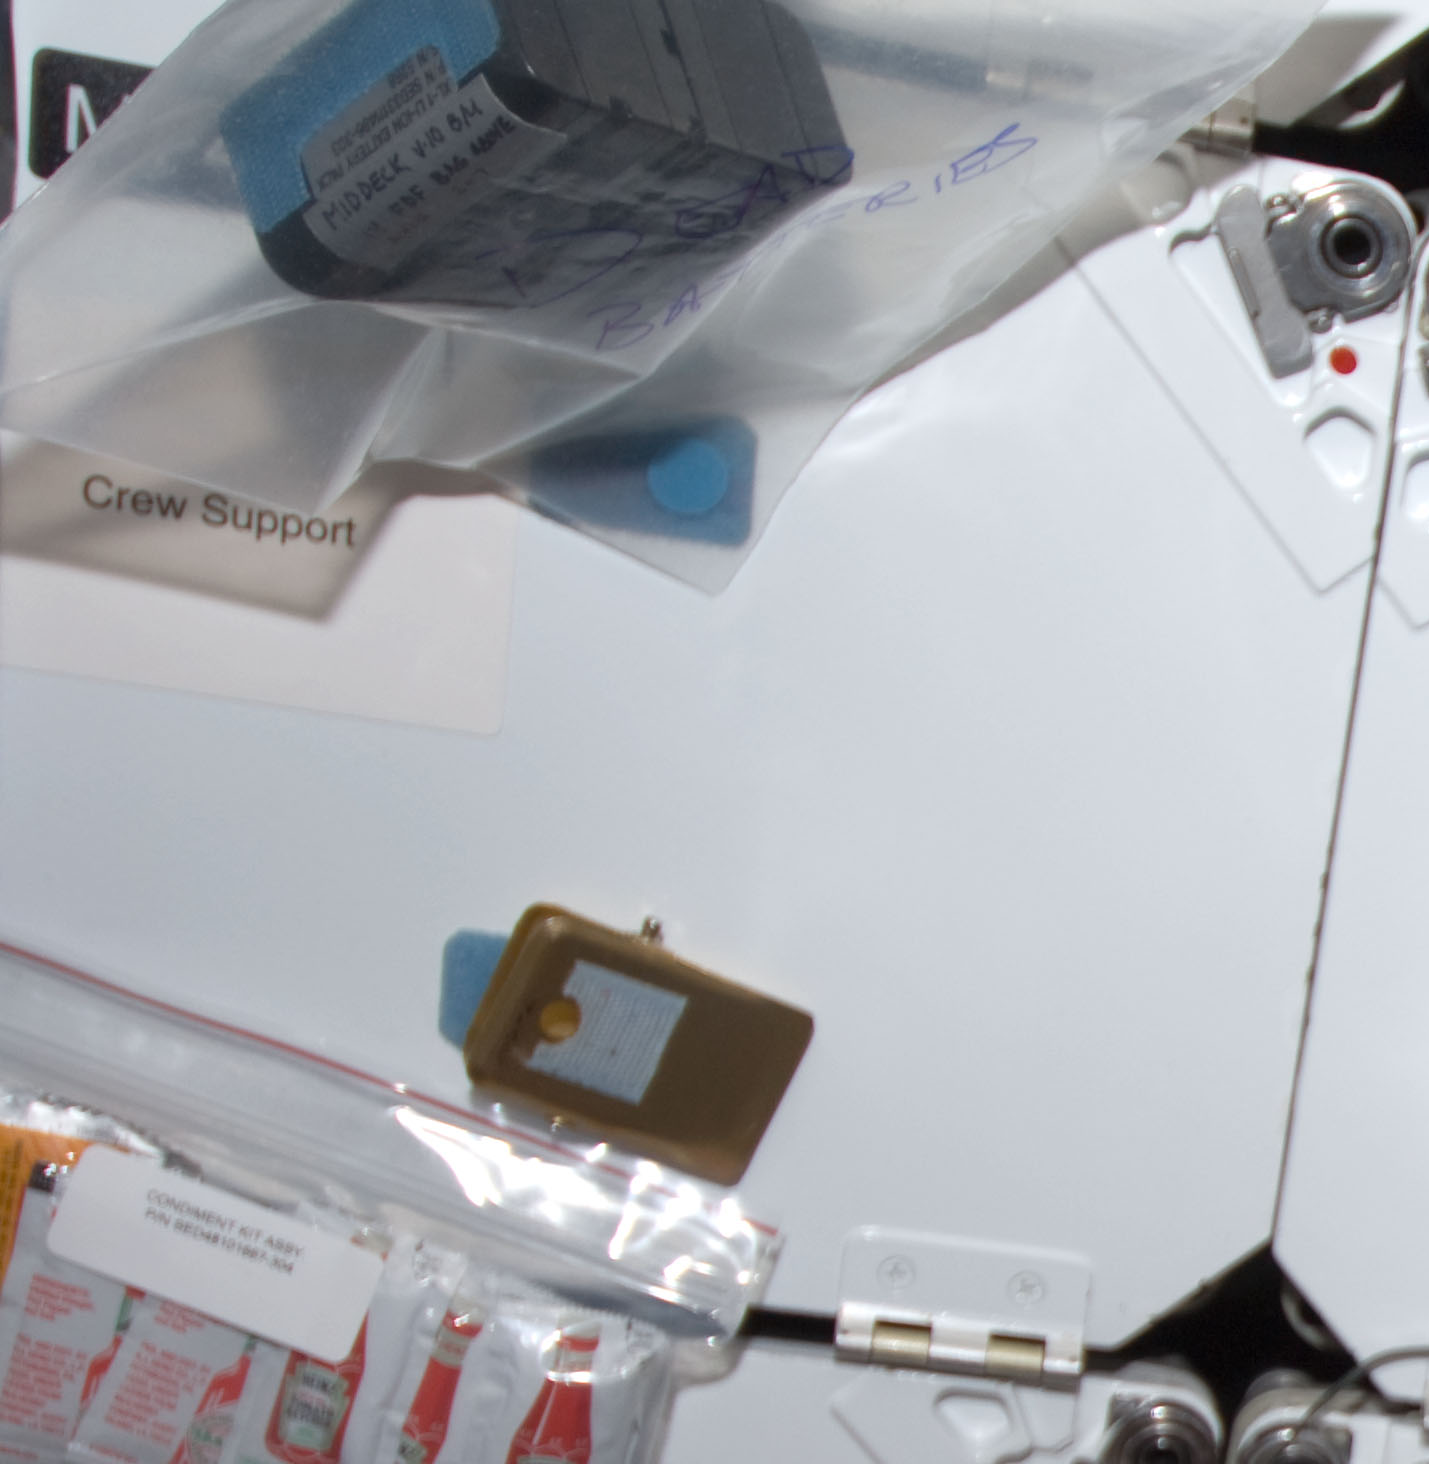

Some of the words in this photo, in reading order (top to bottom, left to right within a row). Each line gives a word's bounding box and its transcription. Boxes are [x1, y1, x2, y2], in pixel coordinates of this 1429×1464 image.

[322, 155, 410, 231] MIDDECK
[82, 473, 188, 520] Crew
[201, 492, 357, 546] Support
[147, 1189, 236, 1232] CONDIMENT
[238, 1224, 263, 1242] KIT
